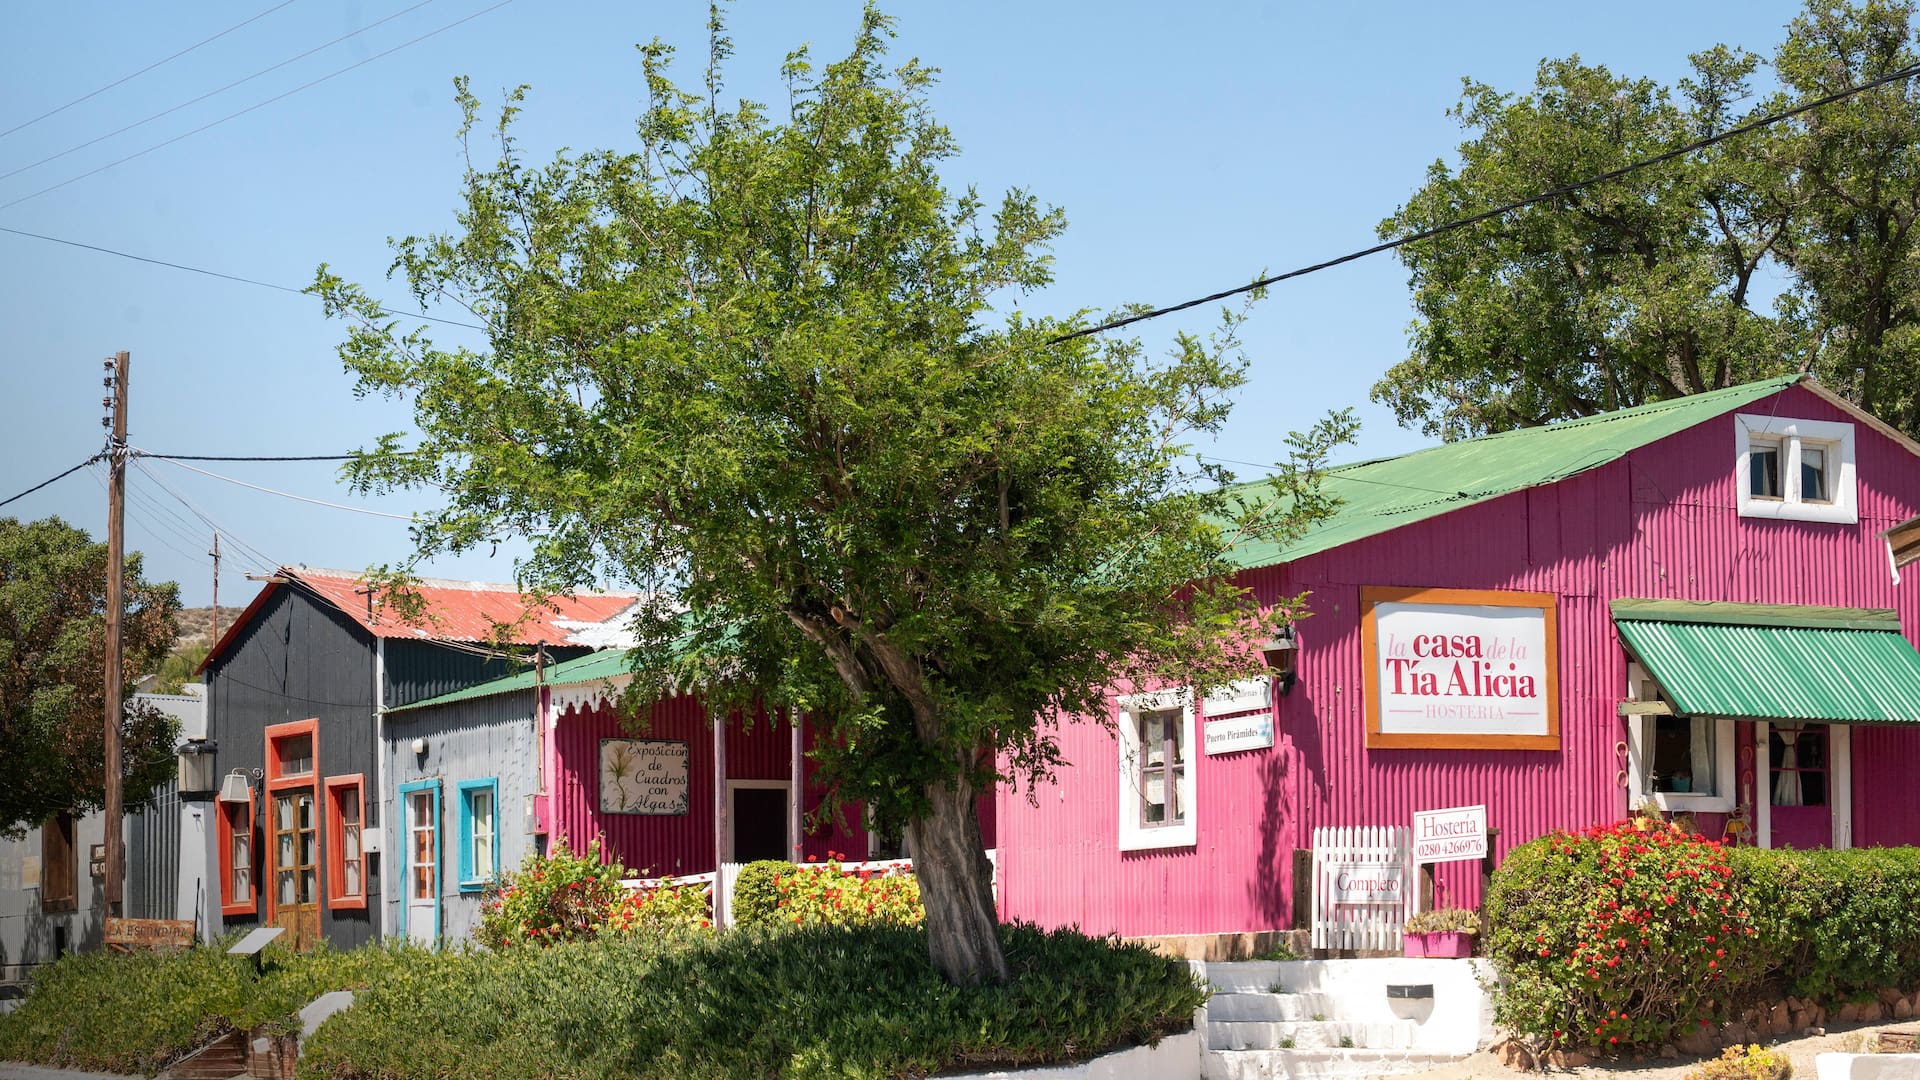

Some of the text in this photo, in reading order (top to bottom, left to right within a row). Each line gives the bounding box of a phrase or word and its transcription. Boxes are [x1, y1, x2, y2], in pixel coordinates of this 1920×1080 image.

[1388, 633, 1527, 660] la casa de la
[1386, 658, 1537, 699] Tía Alicia
[1206, 733, 1226, 743] Puerto
[648, 757, 663, 771] de
[635, 769, 686, 785] Cuadros
[648, 787, 669, 796] con
[627, 794, 676, 814] Algas
[1423, 813, 1478, 838] Hostería
[1418, 839, 1482, 857] 0280 4266976
[1337, 872, 1399, 897] Completo
[109, 924, 122, 937] LA
